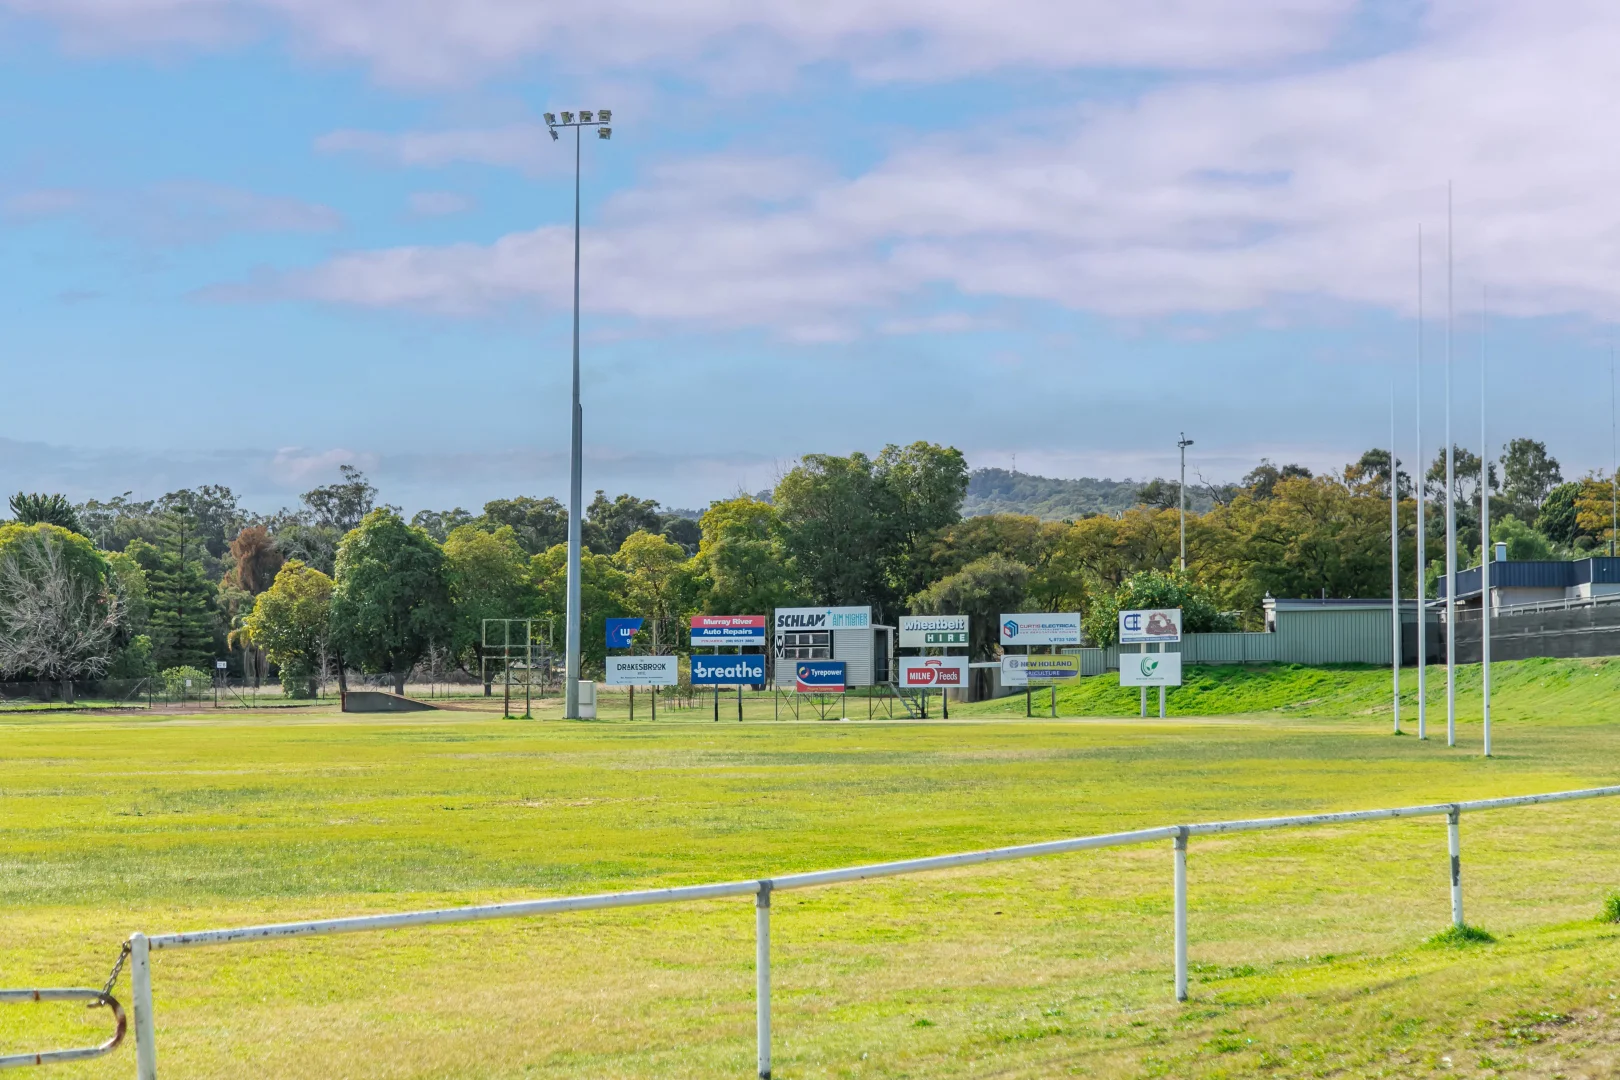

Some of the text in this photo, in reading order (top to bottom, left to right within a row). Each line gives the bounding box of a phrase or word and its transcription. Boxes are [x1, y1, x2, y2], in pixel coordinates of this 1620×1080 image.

[777, 613, 868, 628] SCHLAM AIM HIGHER
[904, 619, 964, 630] wheatbelt
[694, 662, 762, 678] breathe
[939, 672, 957, 680] Feeds
